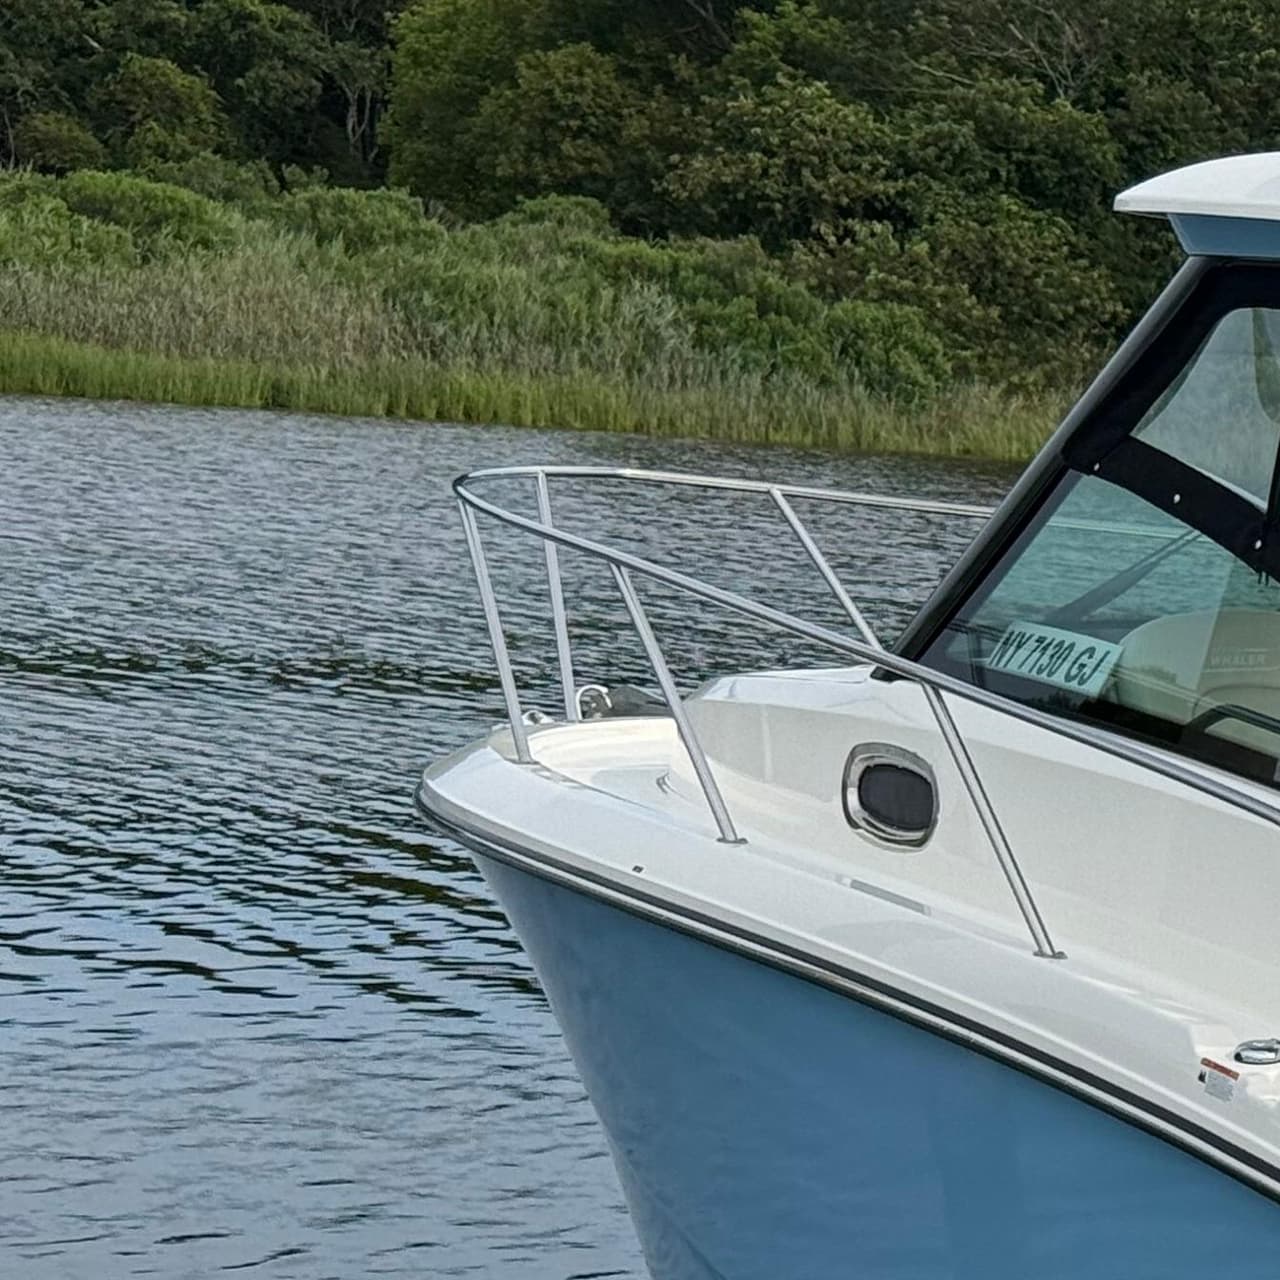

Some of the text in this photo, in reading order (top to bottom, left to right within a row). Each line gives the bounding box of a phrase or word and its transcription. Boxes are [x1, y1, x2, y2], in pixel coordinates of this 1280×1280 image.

[988, 630, 1111, 687] NY 7130 GJ
